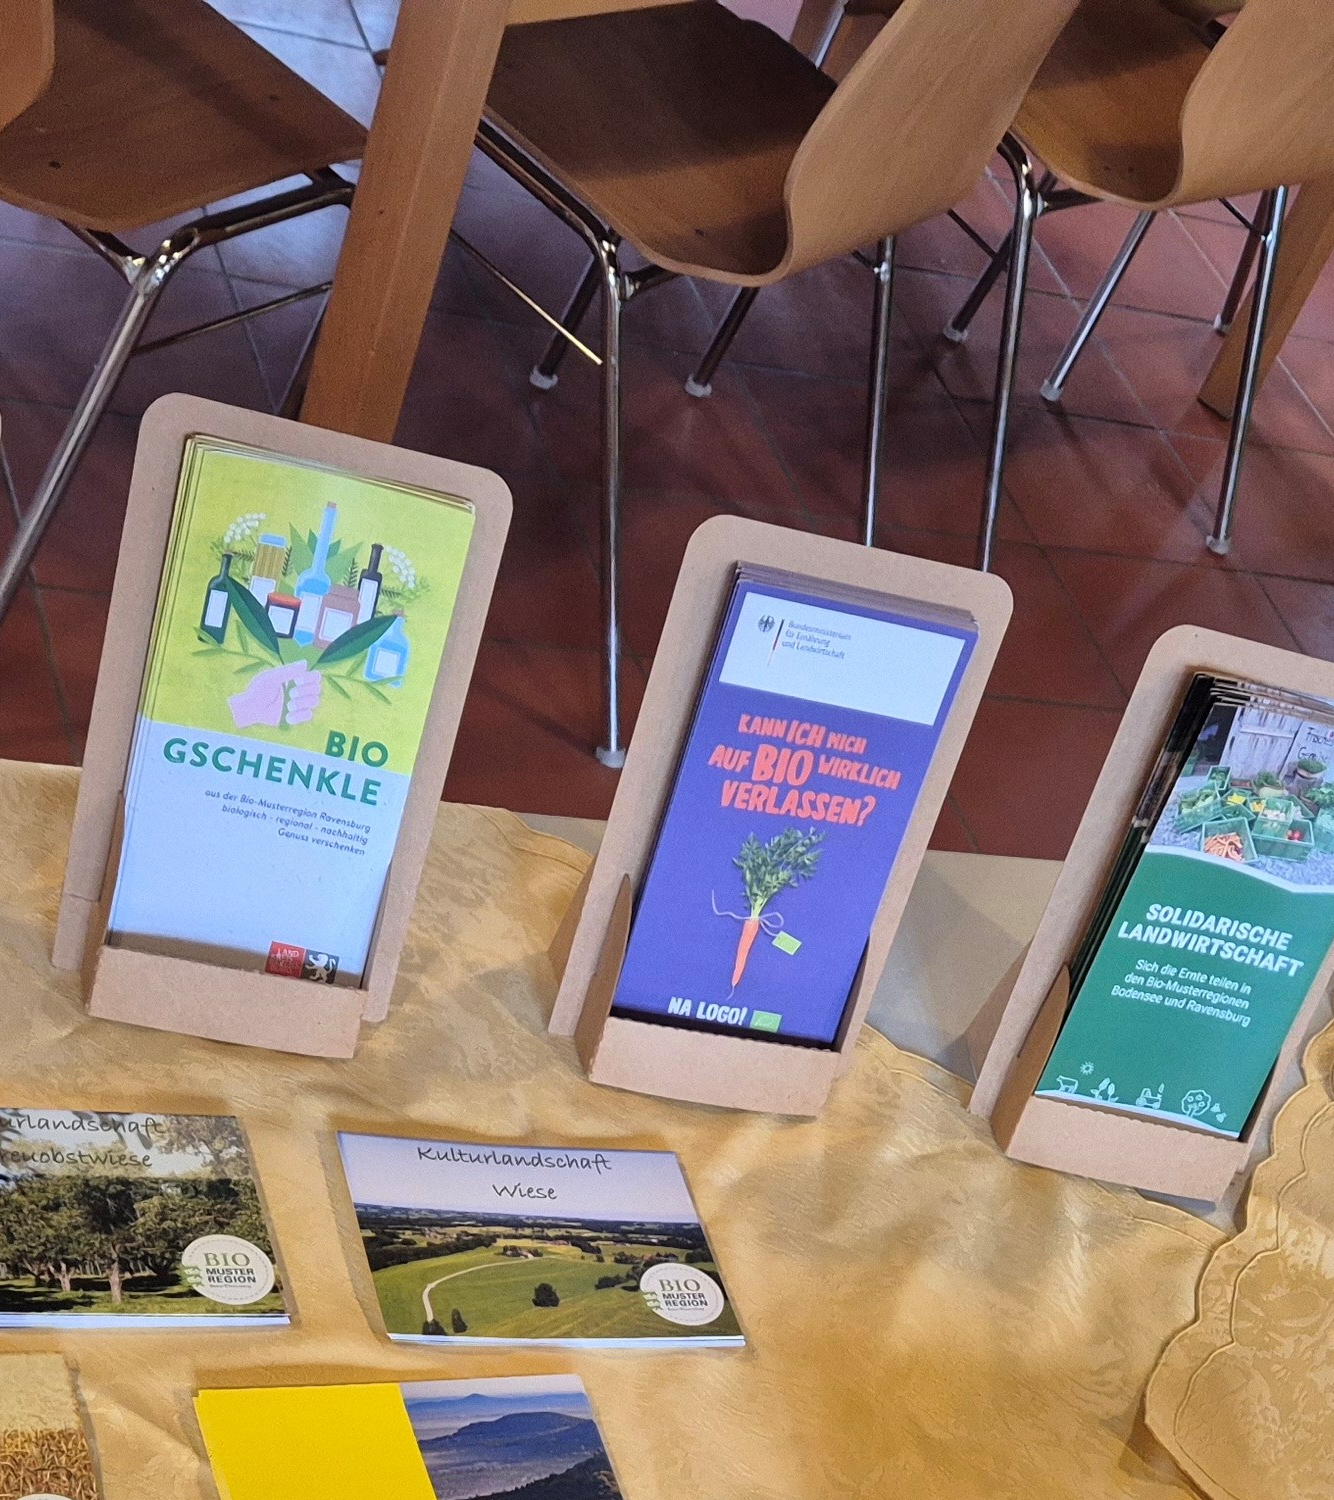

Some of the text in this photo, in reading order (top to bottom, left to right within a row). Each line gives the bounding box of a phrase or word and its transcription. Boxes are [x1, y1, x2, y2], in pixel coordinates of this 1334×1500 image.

[324, 730, 389, 768] BIO
[738, 714, 867, 754] KANN ICH MICH
[163, 738, 381, 806] GSCHENKLE
[708, 743, 902, 790] AUF BIO WIRKLICH
[205, 789, 371, 834] aus der Bio-Musterregion Ravensburg
[721, 780, 876, 827] VERLASSEN?
[278, 827, 309, 843] Genuss
[1146, 903, 1293, 951] SOLIDARISCHE
[1117, 920, 1304, 977] LANDWIRTSCHAFT
[1124, 972, 1249, 1010] den Bio-Musterregionen
[1135, 958, 1252, 995] Sich die Ernte teilen in
[668, 996, 748, 1026] NA LOGO!
[1111, 985, 1251, 1028] Bodensee und Ravensburg
[417, 1146, 612, 1174] Kulturlandschaft
[492, 1182, 558, 1200] Wiese
